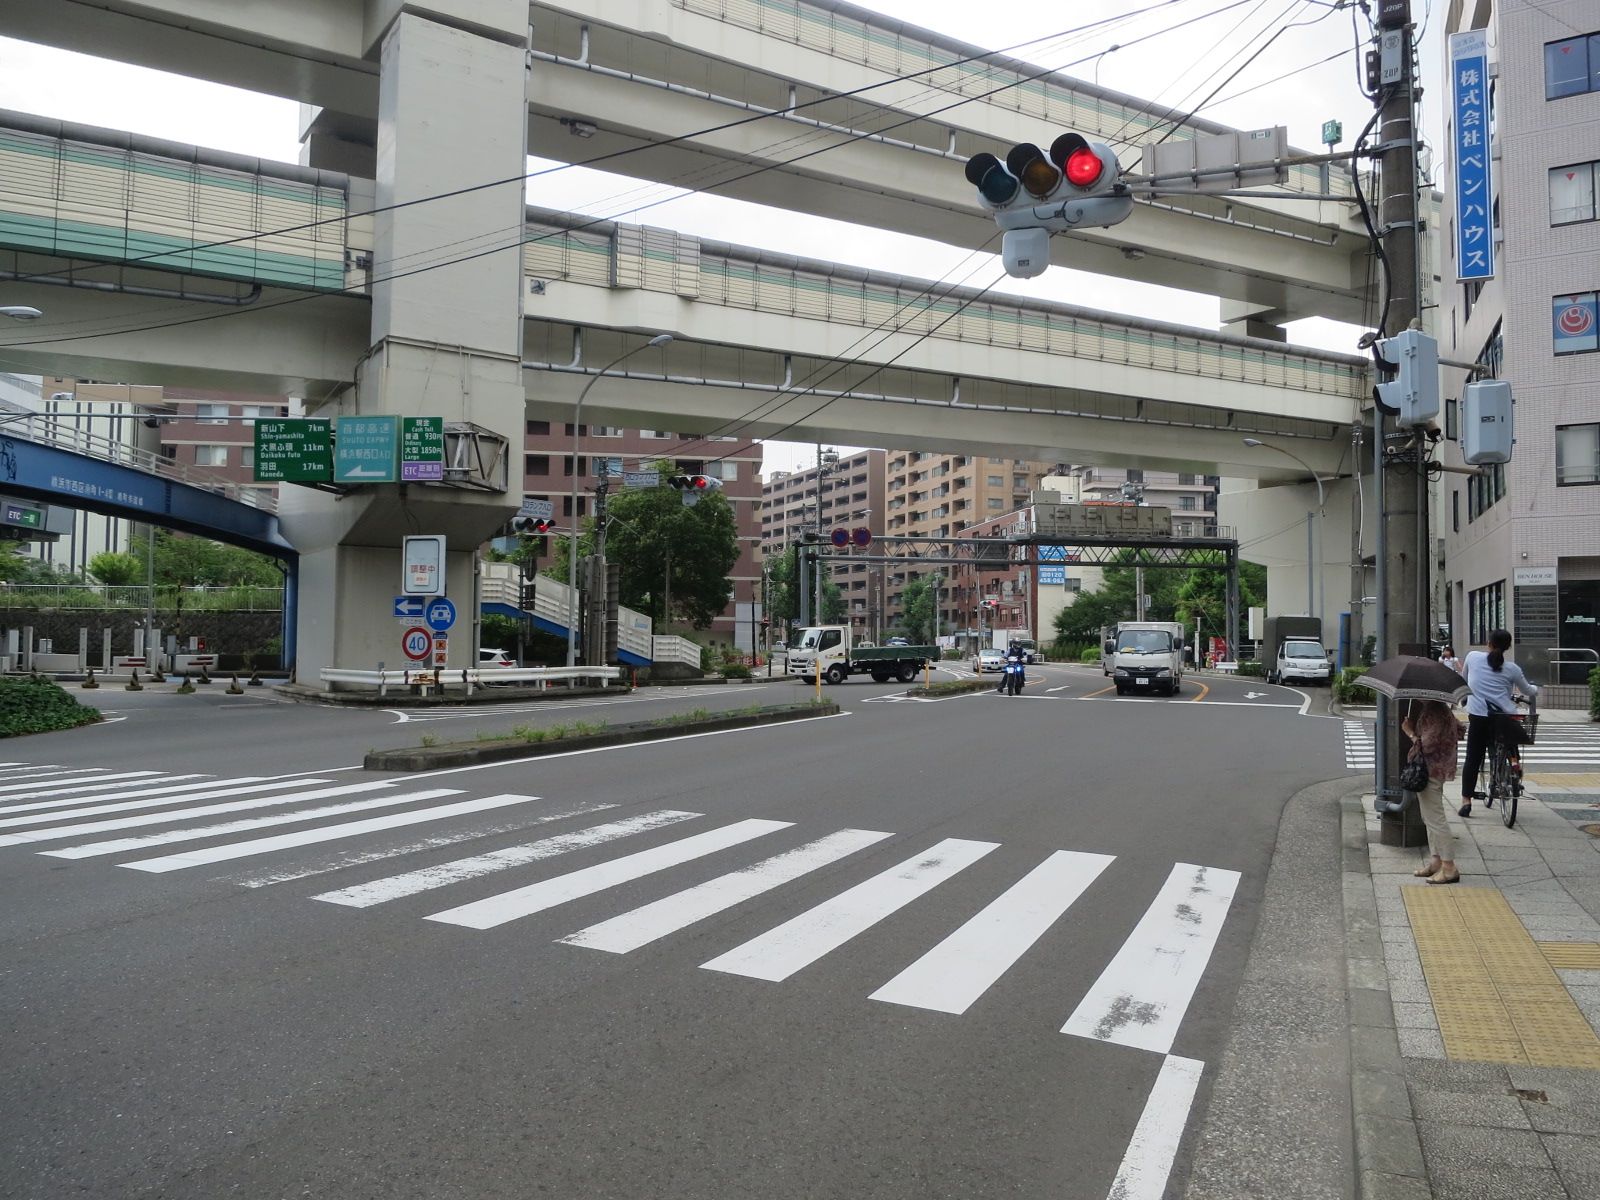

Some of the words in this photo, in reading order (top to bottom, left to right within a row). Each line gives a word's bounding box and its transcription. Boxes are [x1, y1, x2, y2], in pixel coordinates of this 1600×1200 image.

[261, 423, 286, 433] 新山下
[308, 423, 325, 432] 7km
[303, 443, 324, 452] 11km
[302, 462, 324, 471] 17km
[404, 466, 417, 475] ETC
[8, 511, 21, 520] ETC
[408, 637, 426, 651] 40
